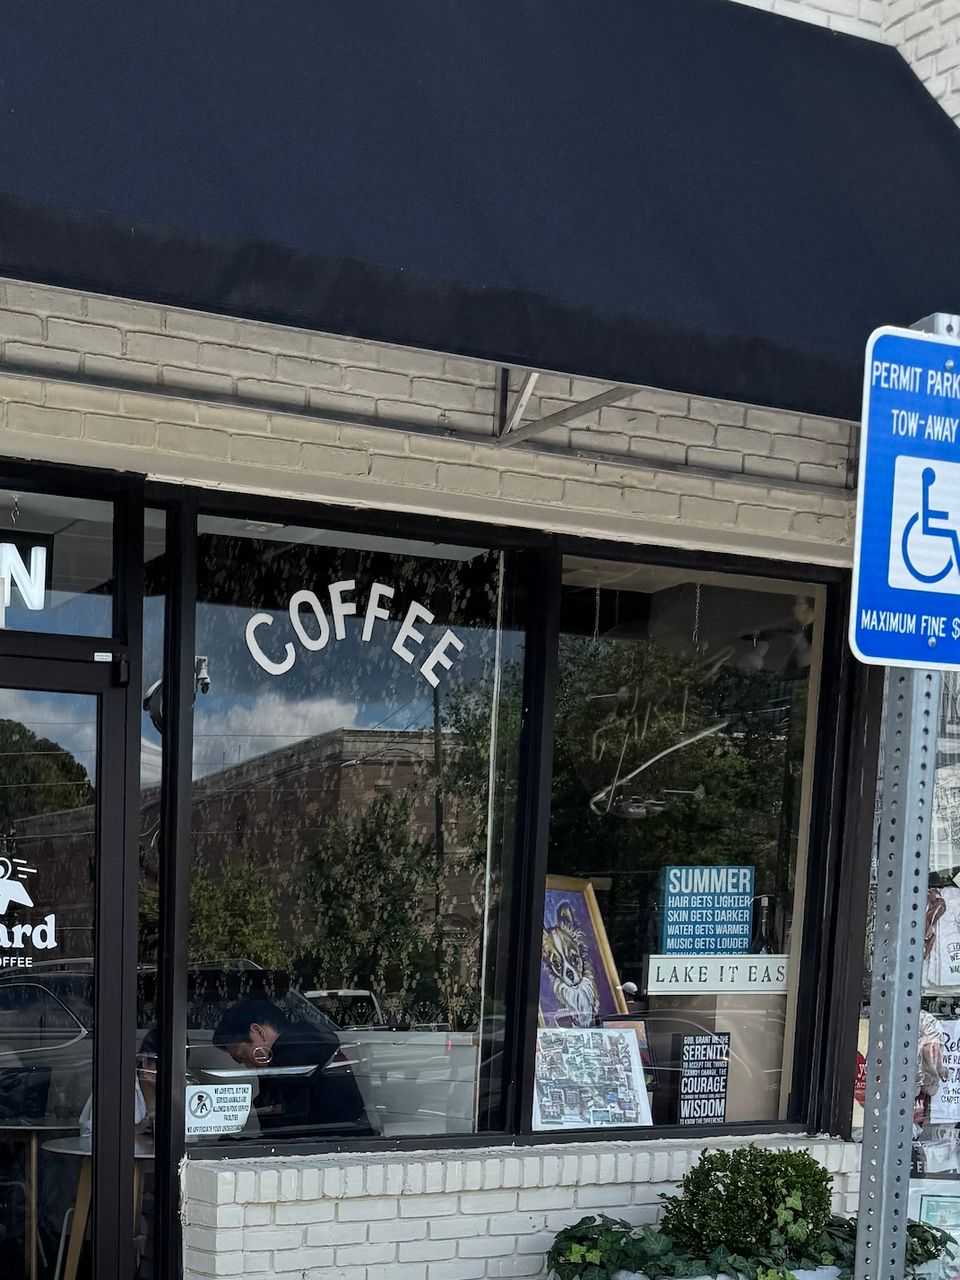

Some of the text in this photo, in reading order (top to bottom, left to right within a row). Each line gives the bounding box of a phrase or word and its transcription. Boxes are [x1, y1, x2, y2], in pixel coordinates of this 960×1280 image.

[872, 361, 923, 393] PERMIT
[891, 408, 959, 443] TOW-AWAY
[861, 609, 916, 635] MAXIMUM
[921, 615, 947, 637] FINE
[245, 579, 464, 688] COFFEE
[669, 868, 751, 894] SUMMER
[668, 895, 750, 908] HAIR GETS LIGHTER
[667, 909, 750, 922] SKIN GETS DARKER
[667, 923, 749, 936] WATER GETS WARMER
[666, 937, 749, 949] MUSIC GETS LOUDER
[656, 965, 708, 983] LAKE
[719, 965, 739, 983] IT
[683, 1045, 728, 1060] SERENITY
[681, 1076, 726, 1093] COURAGE
[680, 1099, 725, 1117] WISDOM
